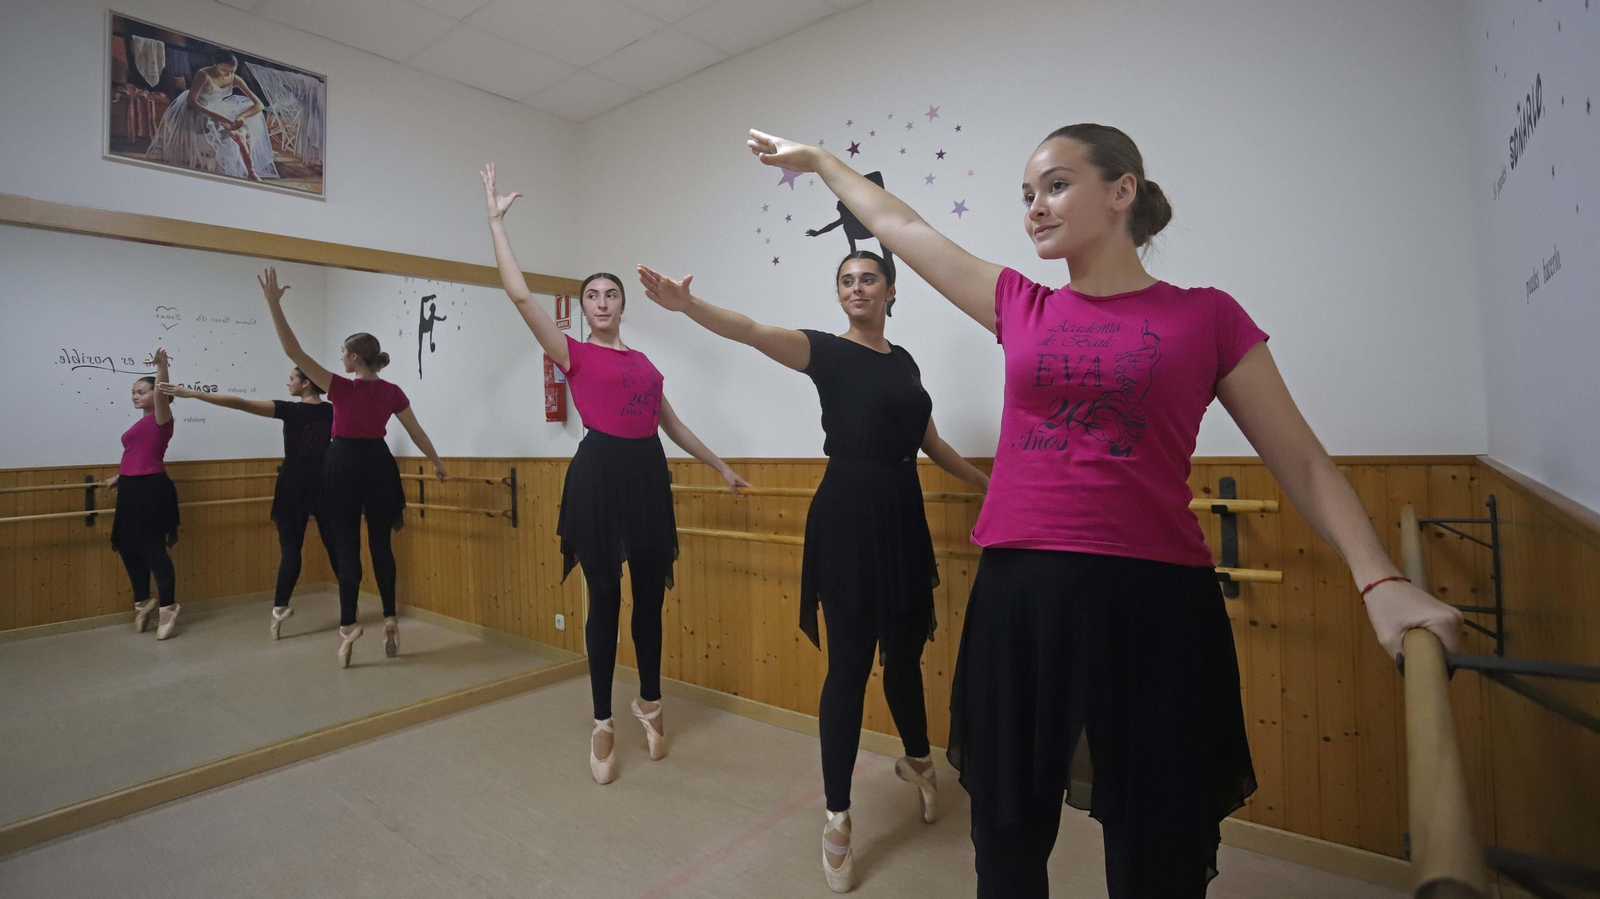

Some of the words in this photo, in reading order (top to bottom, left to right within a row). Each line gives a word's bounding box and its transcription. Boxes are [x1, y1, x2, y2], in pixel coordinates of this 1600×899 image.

[1526, 266, 1540, 305] puedes
[1036, 335, 1057, 346] de
[1061, 334, 1117, 348] Baile
[1046, 320, 1124, 334] Academia
[1033, 353, 1103, 388] EVA
[1038, 397, 1101, 431] 20
[1011, 423, 1071, 452] Años
